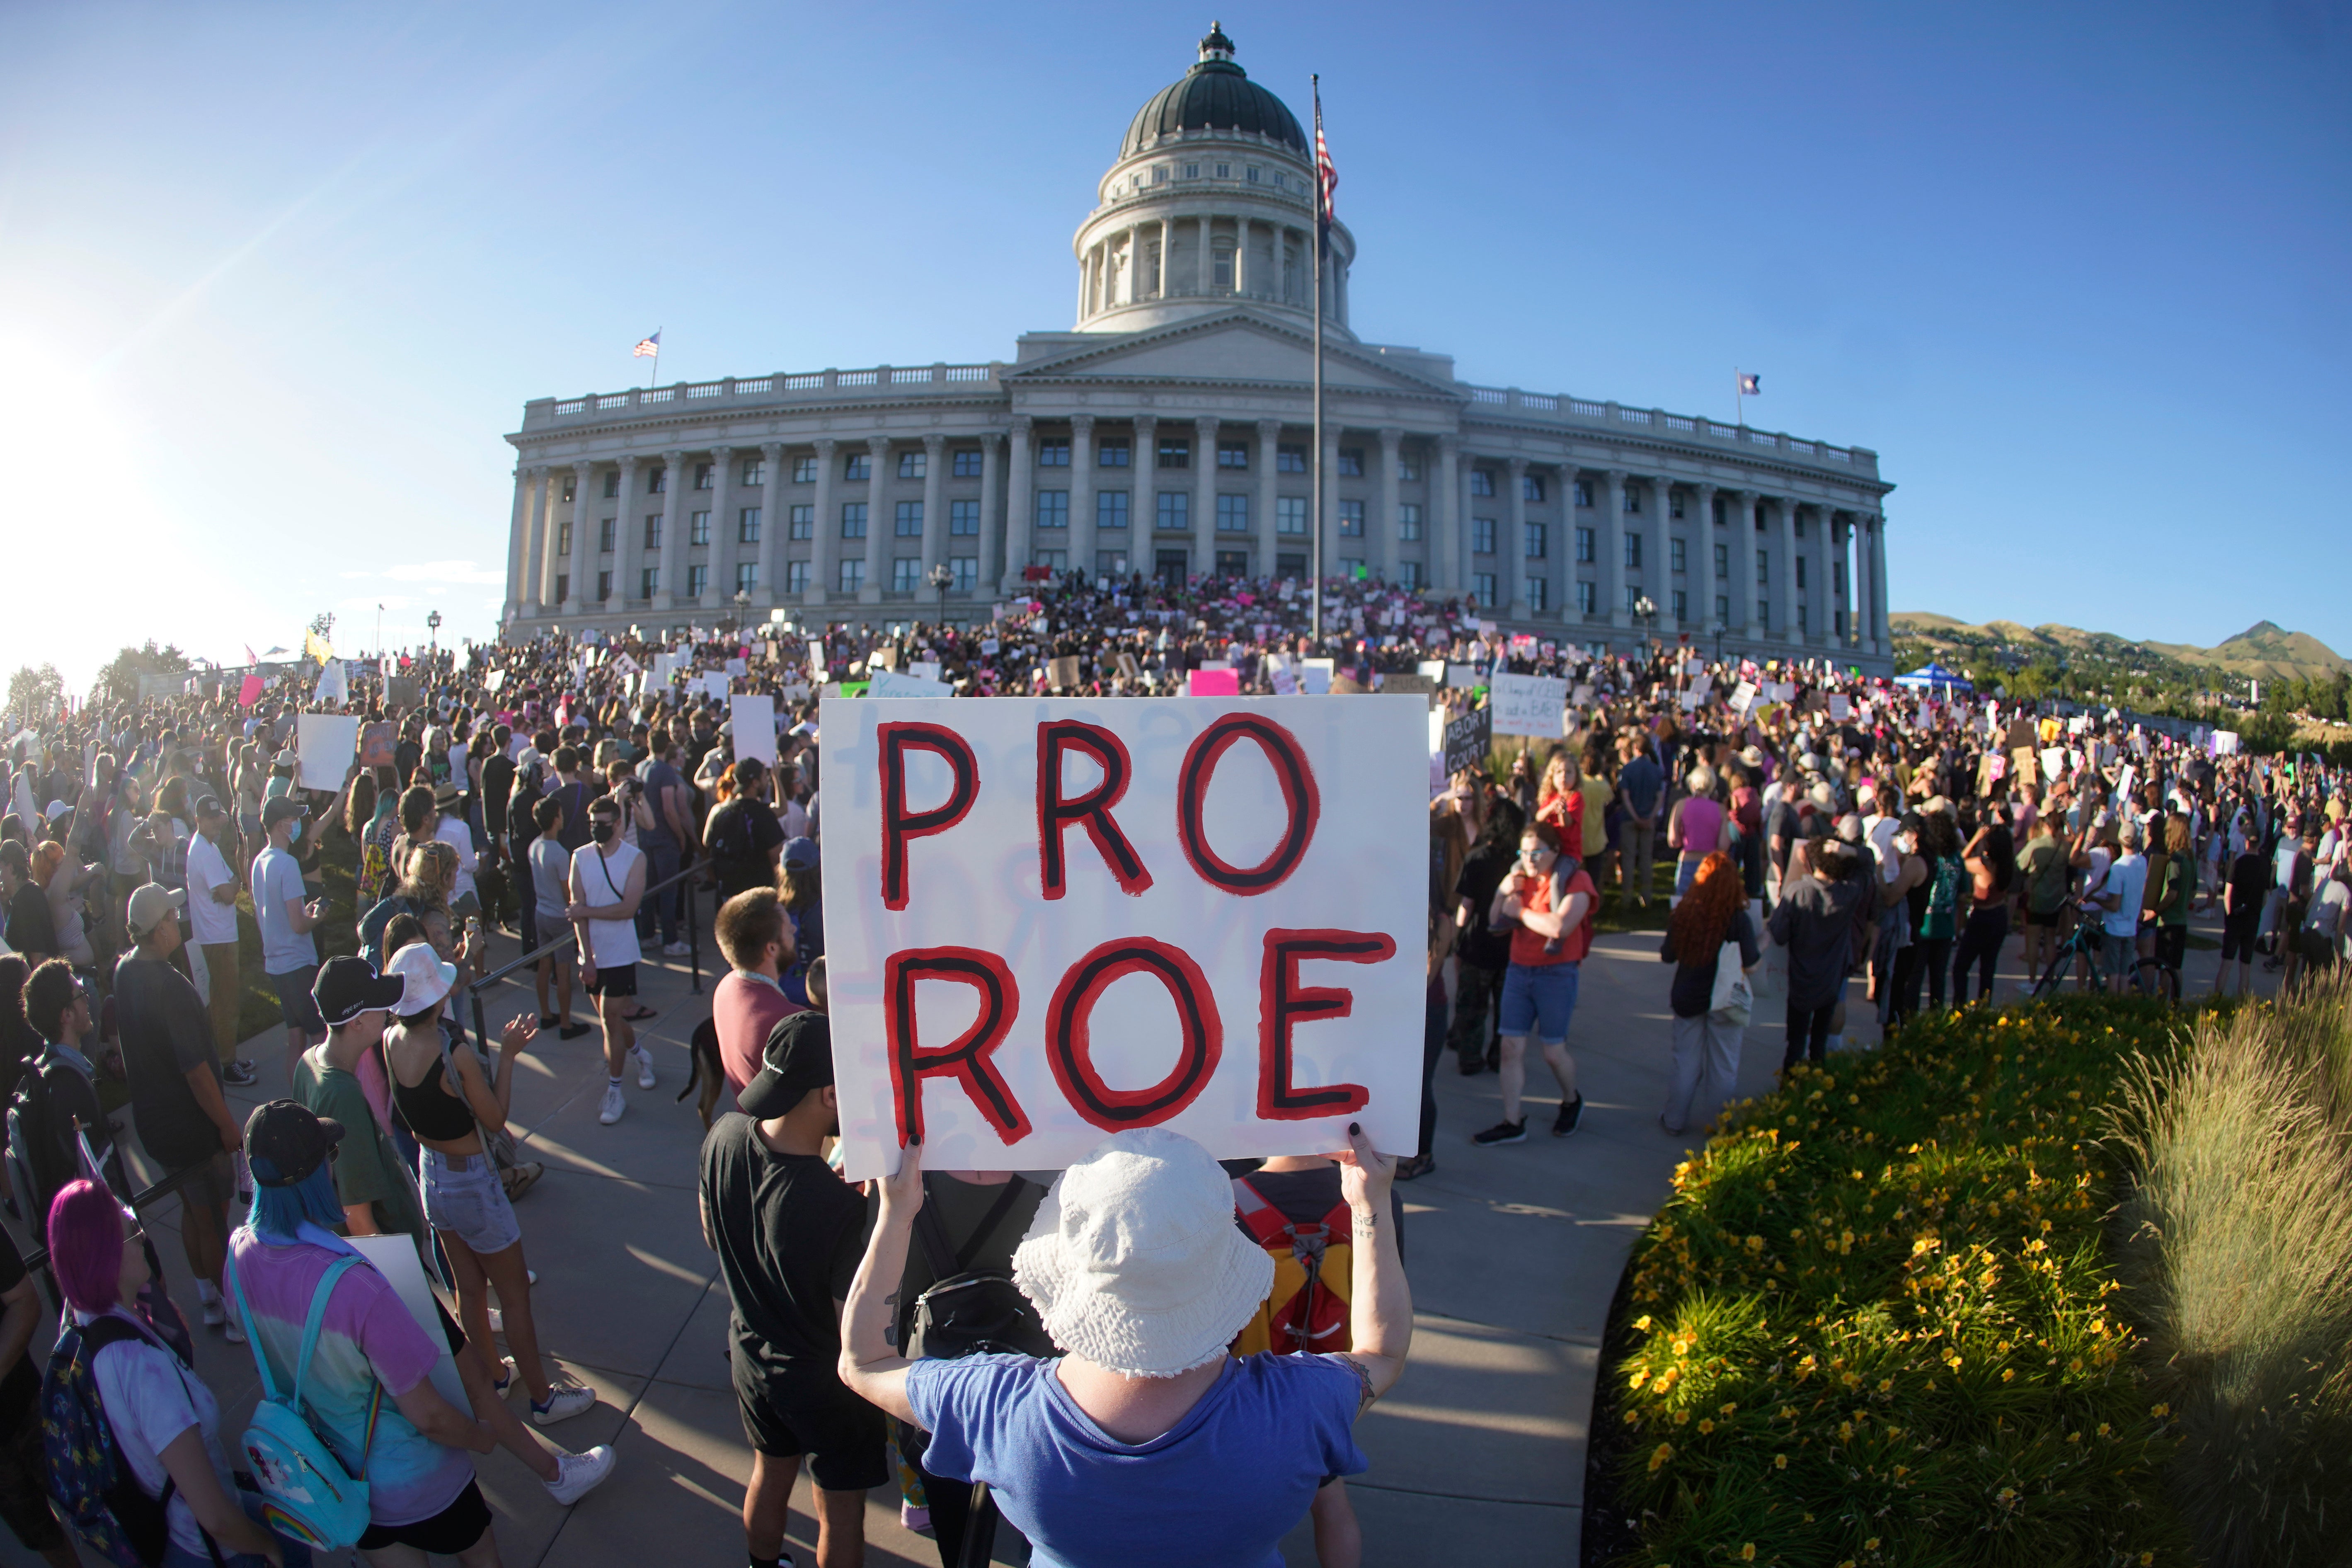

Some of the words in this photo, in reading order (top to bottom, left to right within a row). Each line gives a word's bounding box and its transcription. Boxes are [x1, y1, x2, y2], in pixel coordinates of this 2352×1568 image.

[1391, 676, 1429, 691] FUCK
[366, 725, 391, 739] TRUST
[1447, 707, 1489, 745] ABORT
[1461, 734, 1475, 746] THE
[1448, 739, 1486, 773] COURT
[878, 713, 1319, 911] PRO
[884, 928, 1395, 1149] ROE
